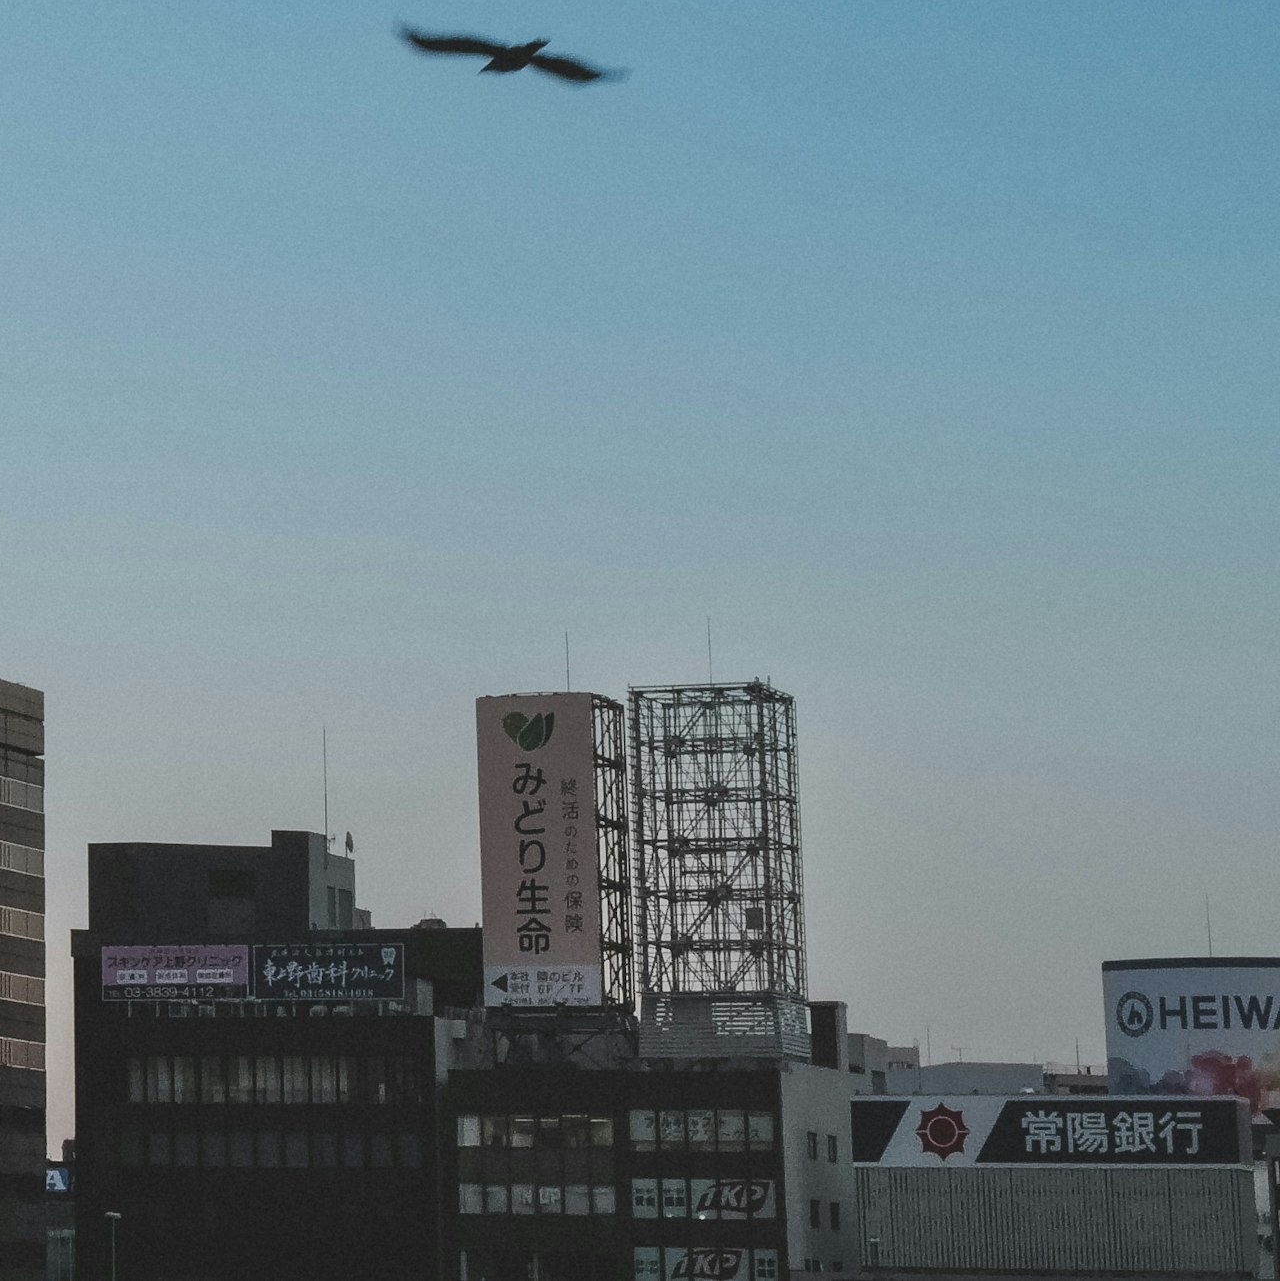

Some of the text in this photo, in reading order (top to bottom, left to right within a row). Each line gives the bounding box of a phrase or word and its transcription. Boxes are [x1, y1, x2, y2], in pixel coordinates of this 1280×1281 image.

[512, 762, 552, 955] みどり生命
[560, 778, 584, 933] 終活のための保険
[263, 959, 395, 988] 東上野歯科クリニック
[1020, 1110, 1204, 1155] 常陽銀行
[702, 1183, 767, 1208] TKP
[678, 1253, 739, 1276] TKP
